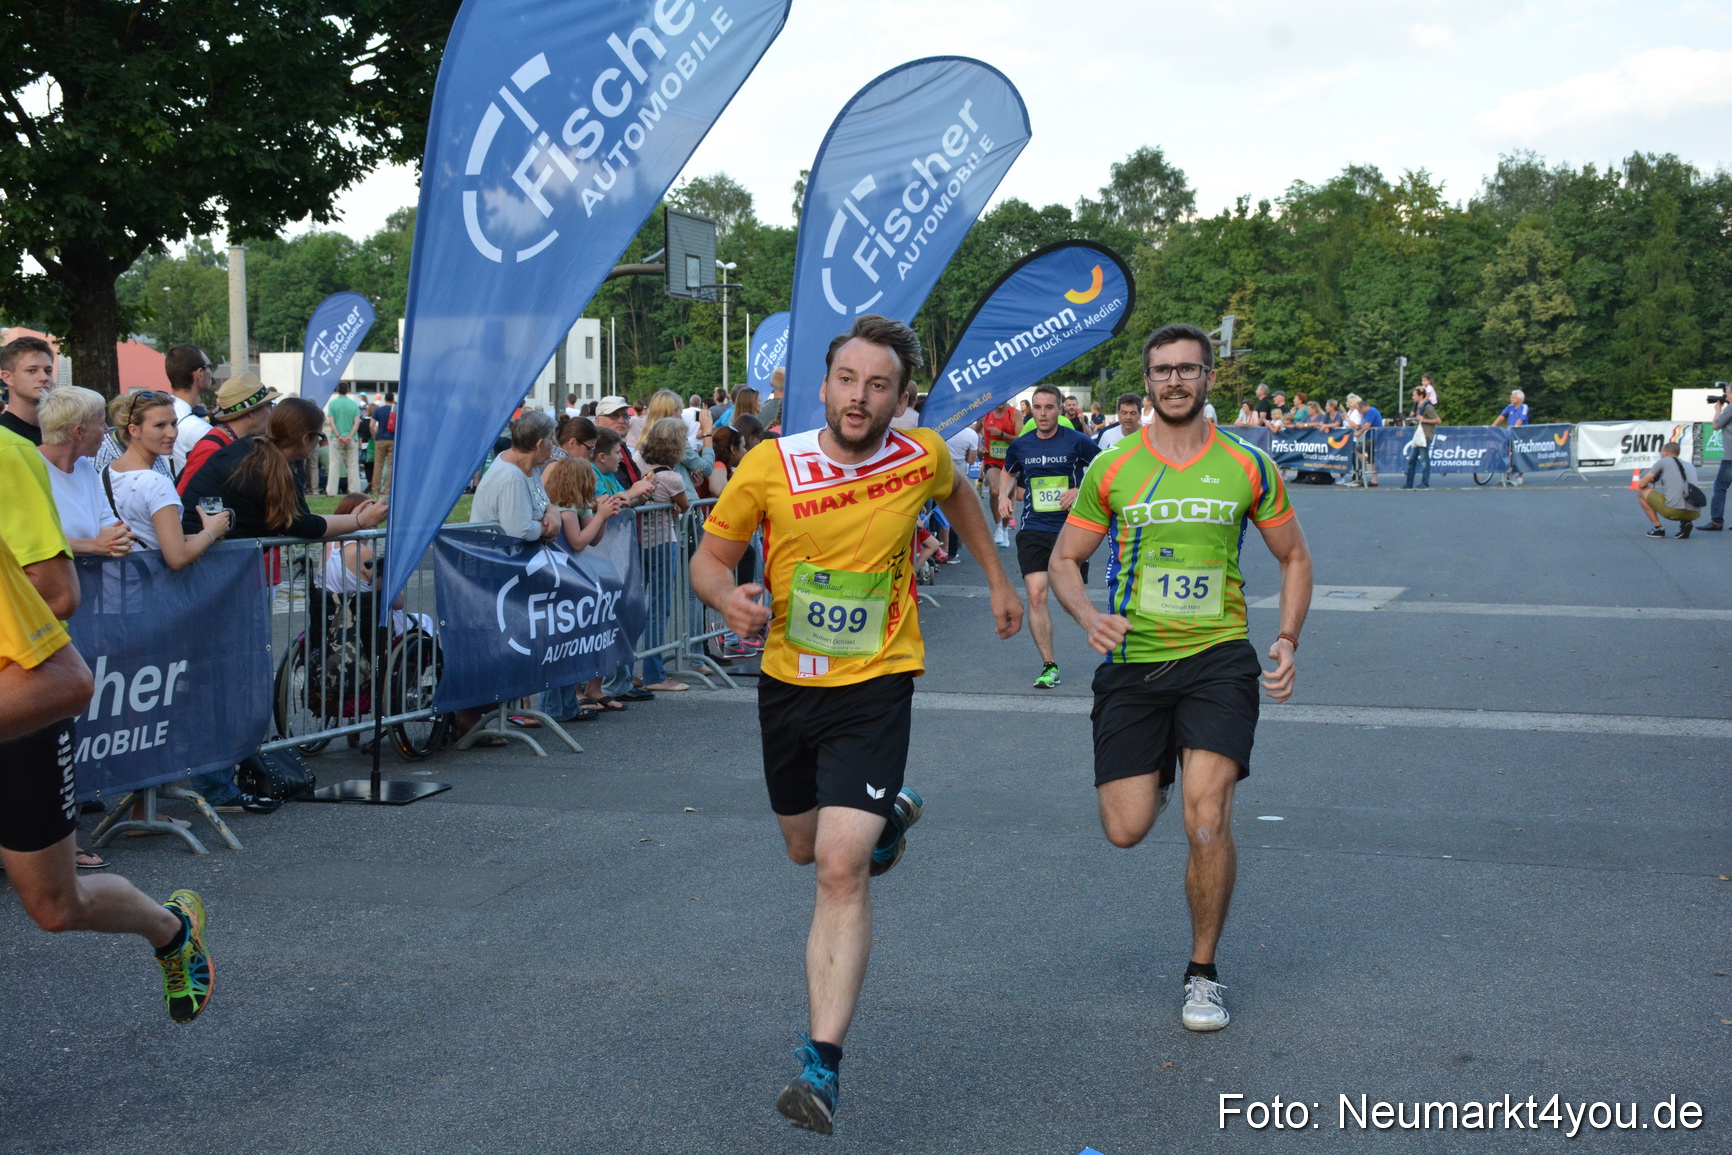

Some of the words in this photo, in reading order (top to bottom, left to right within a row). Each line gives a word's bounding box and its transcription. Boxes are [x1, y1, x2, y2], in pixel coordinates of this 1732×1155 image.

[512, 0, 703, 218] Fische
[580, 5, 734, 218] AUTOMOBILE
[852, 98, 979, 284] Fischer
[897, 134, 994, 281] AUTOMOBILE
[320, 305, 361, 366] Fischer
[333, 317, 365, 366] AUTOMOBILE
[762, 325, 790, 371] Fische
[947, 307, 1077, 392] Frischmann
[1030, 331, 1062, 358] Druck
[1062, 322, 1083, 338] und
[1084, 297, 1122, 328] Medien
[1025, 457, 1041, 465] EURO
[1271, 440, 1328, 453] Frischmann
[1327, 454, 1348, 462] Medien
[1429, 446, 1487, 459] ischer
[1513, 440, 1555, 453] Frischmann
[792, 488, 859, 520] MAX
[866, 465, 935, 500] BÖGL
[1039, 490, 1062, 502] 362
[1122, 498, 1239, 528] BOCK
[708, 514, 730, 530] gl.de
[1157, 573, 1210, 599] 135
[527, 581, 623, 640] Fischr
[807, 601, 868, 633] 899
[74, 655, 188, 723] her
[74, 720, 169, 764] MOBILE
[57, 730, 76, 821] skinfit
